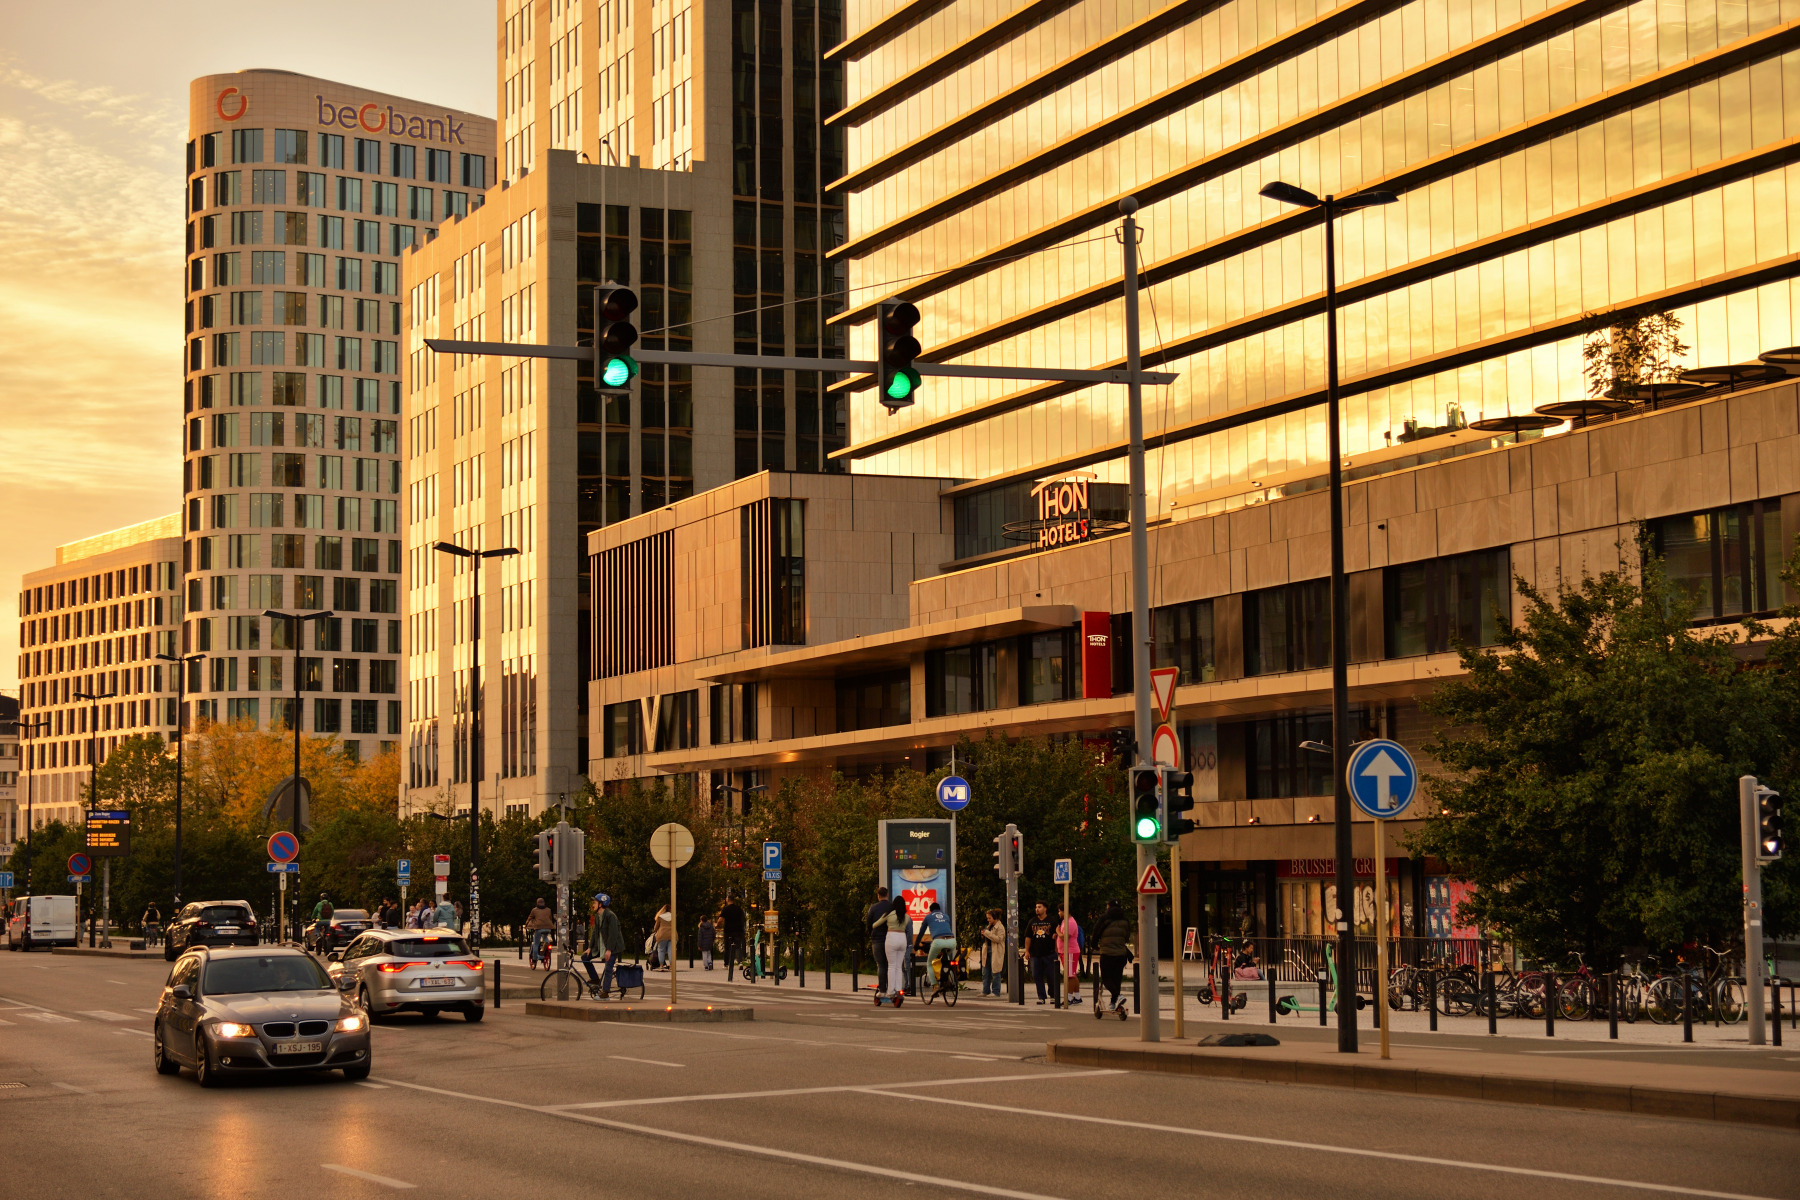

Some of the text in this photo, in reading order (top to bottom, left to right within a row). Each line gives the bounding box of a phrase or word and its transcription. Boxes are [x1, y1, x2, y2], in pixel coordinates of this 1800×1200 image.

[1031, 471, 1097, 520] THON
[1040, 520, 1088, 547] HOTELS
[944, 787, 966, 800] M
[910, 831, 930, 839] Rogier
[766, 846, 779, 866] P
[400, 861, 408, 871] P
[1291, 858, 1337, 874] BRUSSEL
[278, 1043, 321, 1052] 1-XSJ-195
